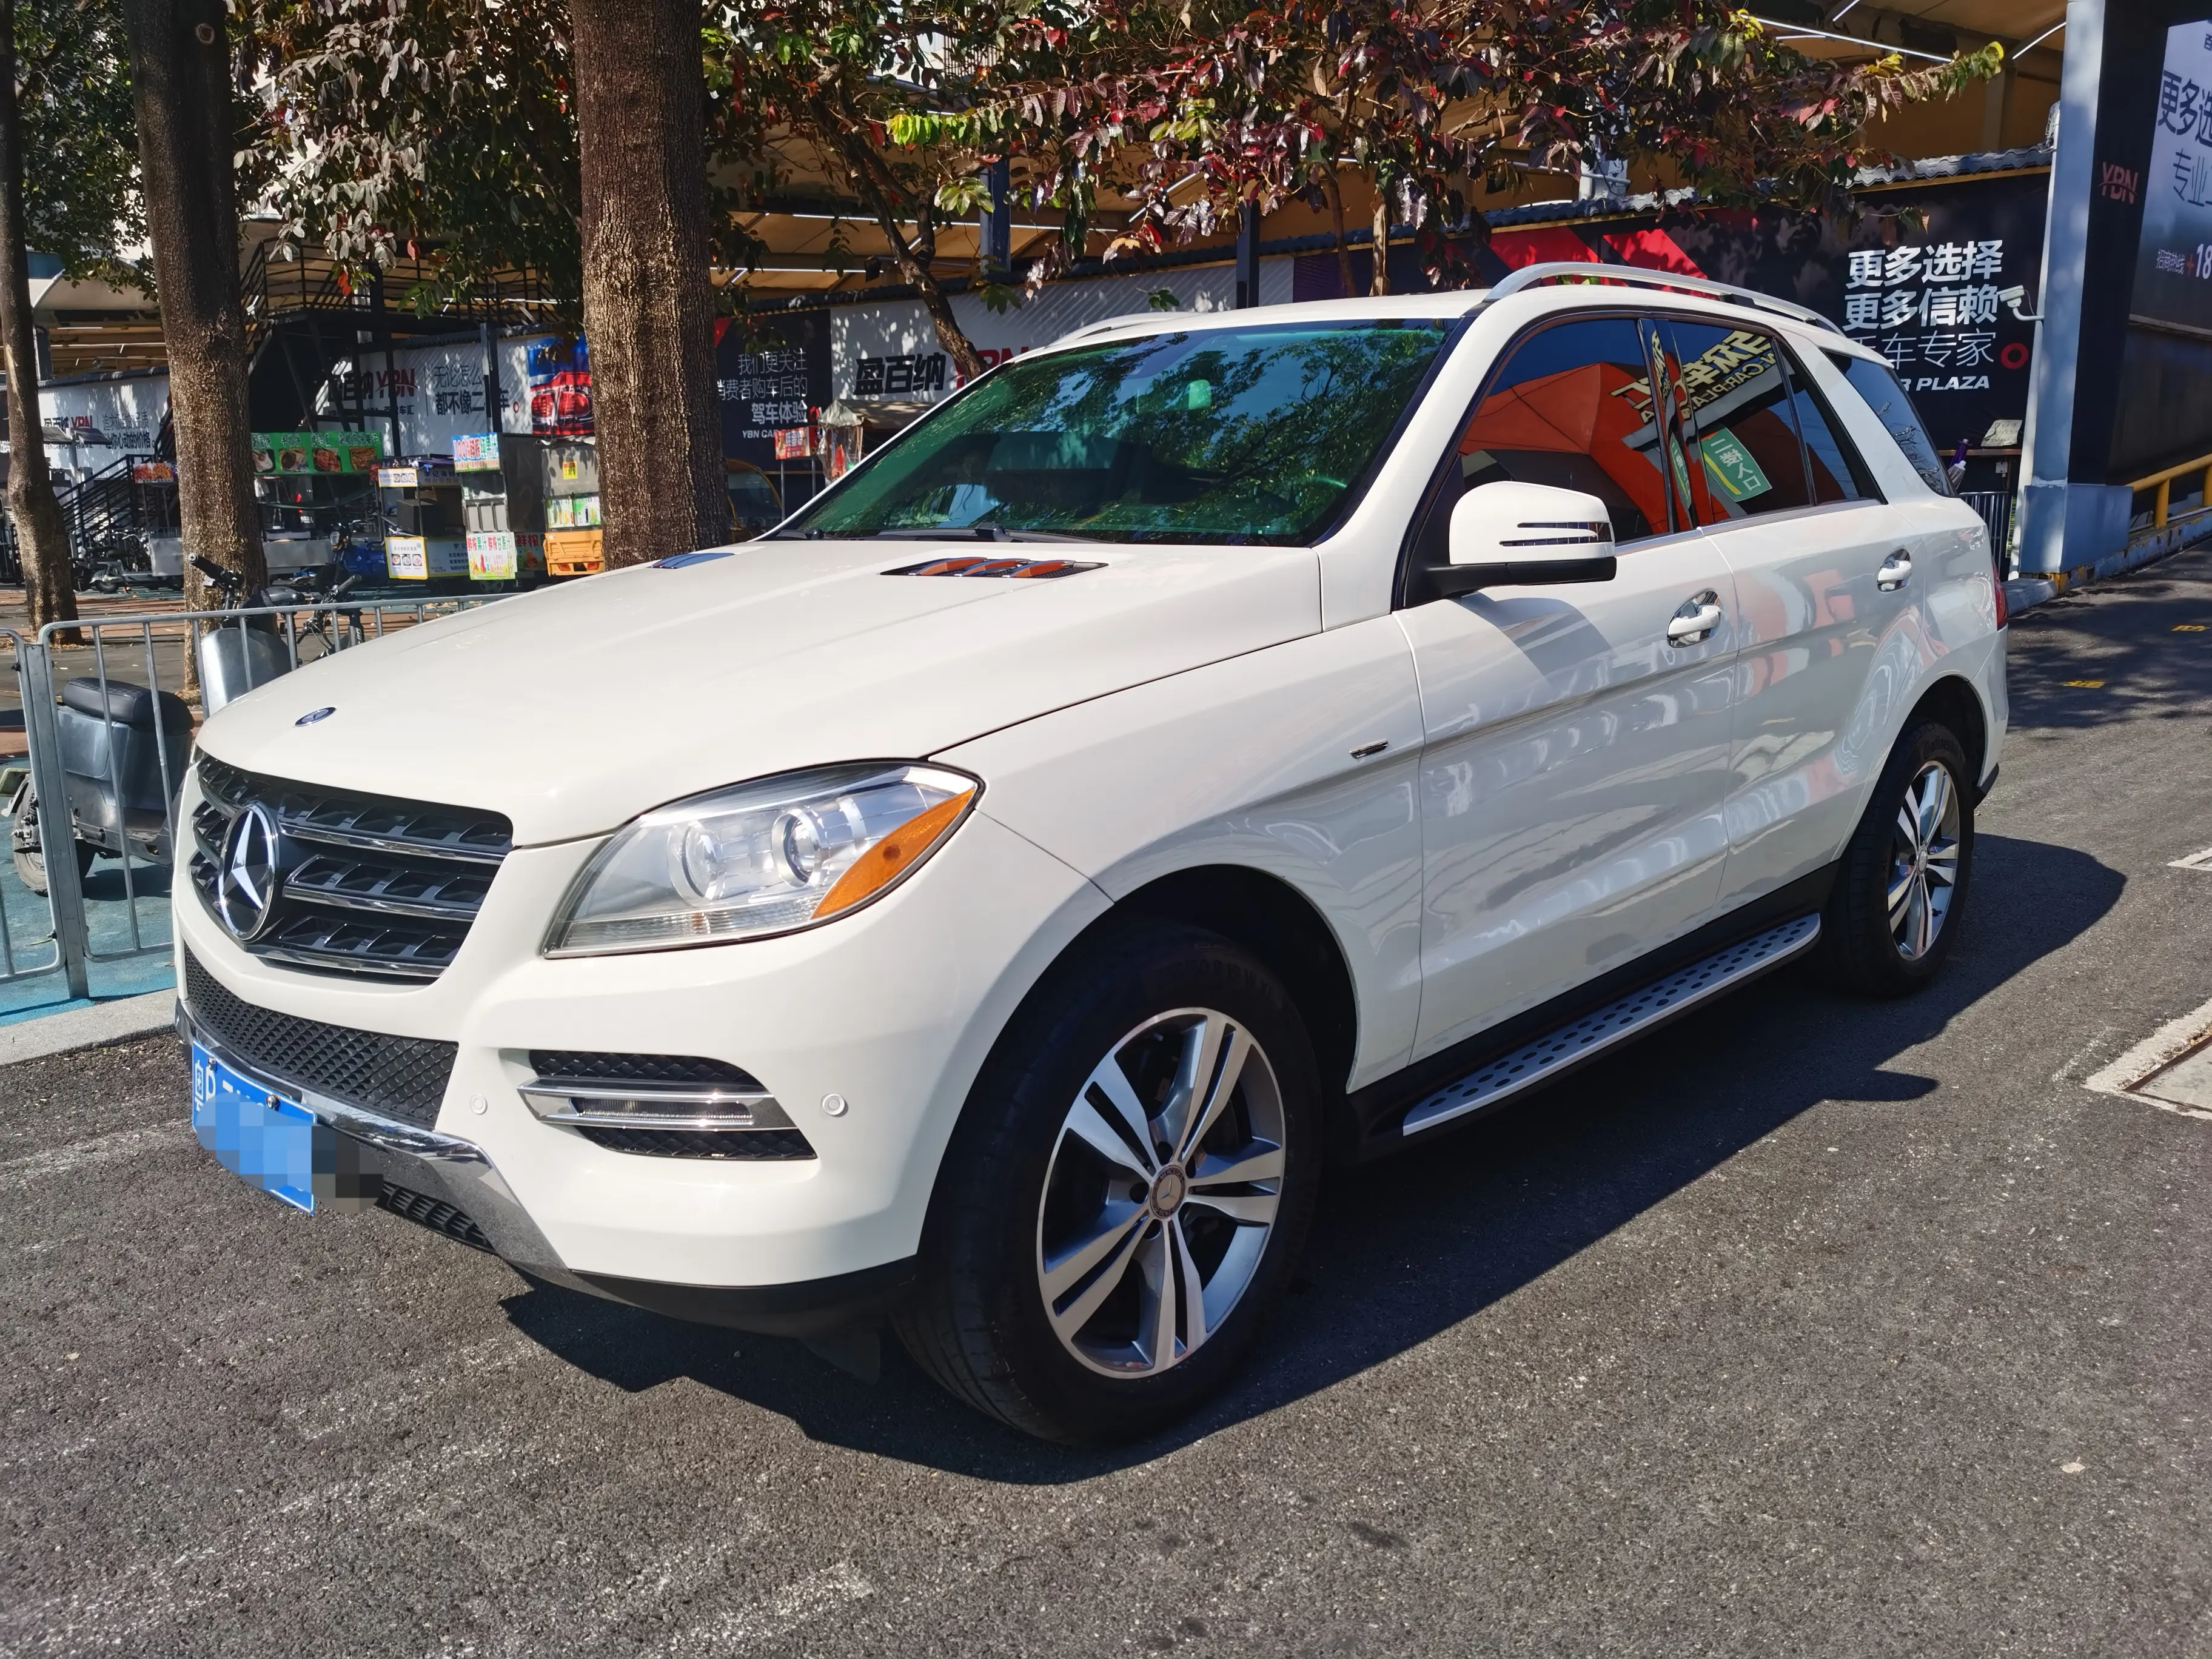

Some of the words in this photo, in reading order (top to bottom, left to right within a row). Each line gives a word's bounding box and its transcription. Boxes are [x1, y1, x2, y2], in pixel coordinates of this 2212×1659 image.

[2099, 161, 2139, 204] YBN
[2173, 149, 2212, 207] 专业
[1846, 240, 2003, 289] 更多选择
[2156, 249, 2185, 274] 招商热线
[1842, 284, 1999, 331] 更多信赖
[738, 347, 808, 375] 我们更关注
[854, 352, 947, 395] 盈百纳
[434, 363, 483, 388] 无论怎么
[1916, 375, 1990, 391] PLAZA
[435, 389, 511, 416] 都不像二车
[751, 400, 808, 424] 驾车体验
[742, 430, 759, 438] YBN
